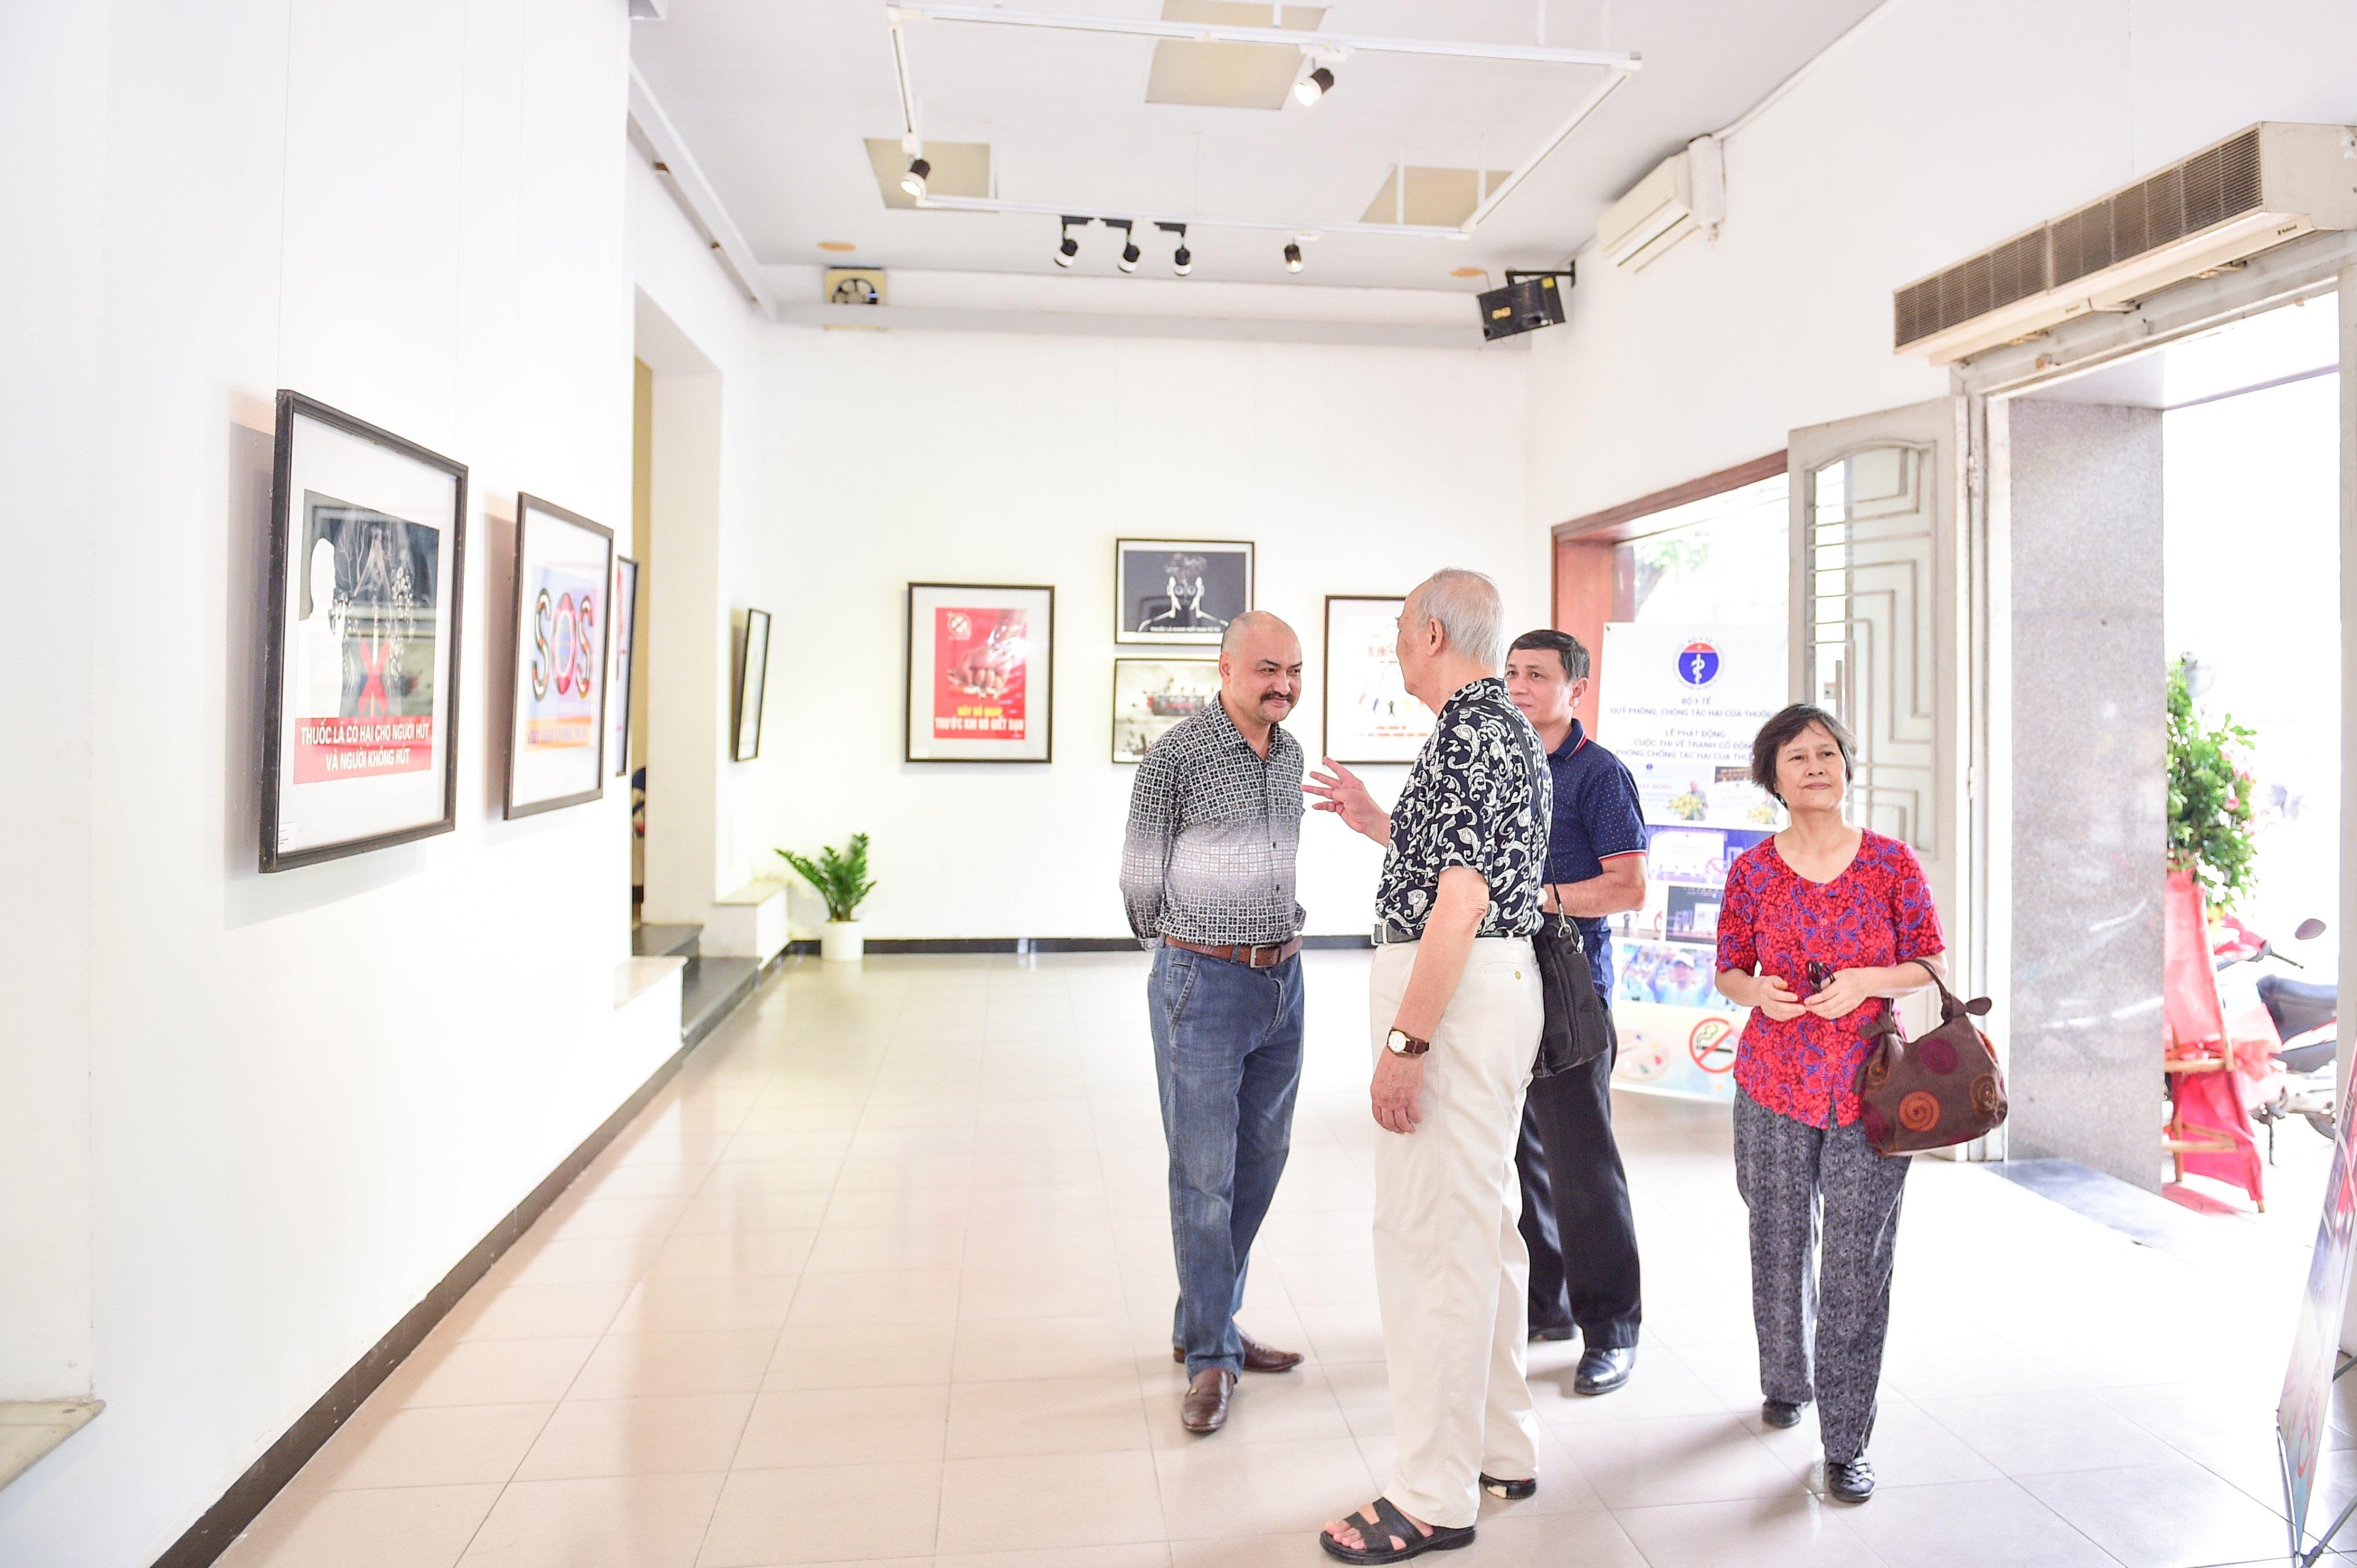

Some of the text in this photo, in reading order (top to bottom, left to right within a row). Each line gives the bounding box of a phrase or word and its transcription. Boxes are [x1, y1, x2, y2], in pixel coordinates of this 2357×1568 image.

[531, 588, 594, 701] SOS
[300, 718, 429, 747] THUỐC LÁ CÓ HẠI CHO NGƯỜI HÚT
[326, 744, 411, 772] VÀ NGƯỜI KHÔNG HÚT
